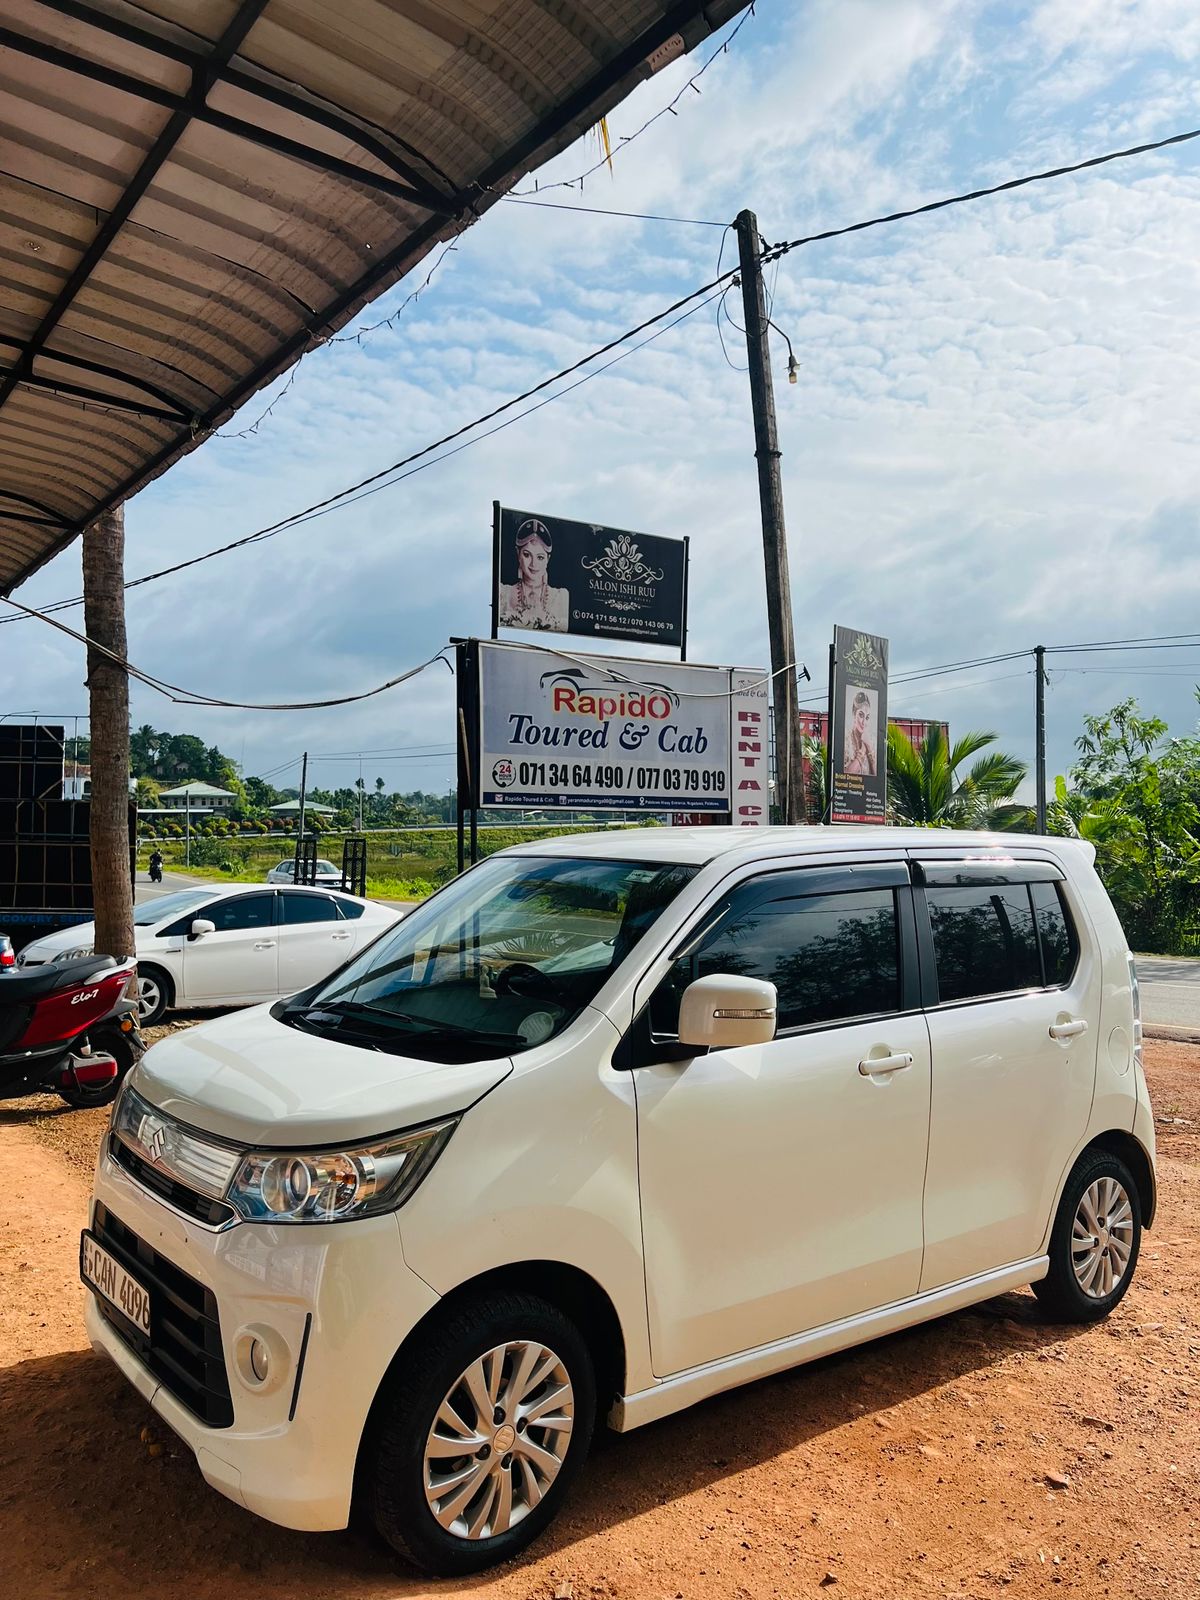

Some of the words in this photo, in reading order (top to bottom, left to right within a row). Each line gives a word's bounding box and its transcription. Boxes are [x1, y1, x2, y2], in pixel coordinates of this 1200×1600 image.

[589, 579, 618, 592] SALON
[620, 583, 636, 595] ISHI
[638, 586, 656, 598] RUU
[581, 612, 594, 620] 074
[619, 617, 627, 625] 12
[631, 618, 644, 626] 070
[644, 620, 656, 628] 143
[656, 621, 665, 629] 06
[666, 622, 674, 630] 79
[508, 714, 610, 749] Toured
[619, 722, 649, 750] &
[658, 724, 708, 754] Cab
[738, 711, 762, 767] RENT
[499, 765, 511, 774] 24
[519, 762, 545, 786] 071
[549, 763, 569, 788] 34
[572, 765, 592, 788] 64
[594, 766, 624, 790] 490
[626, 766, 634, 790] /
[637, 768, 661, 790] 077
[663, 768, 681, 791] 03
[684, 769, 700, 792] 79
[702, 770, 726, 792] 919
[738, 780, 762, 790] A
[94, 1249, 117, 1300] CAN
[119, 1275, 150, 1330] 4096
